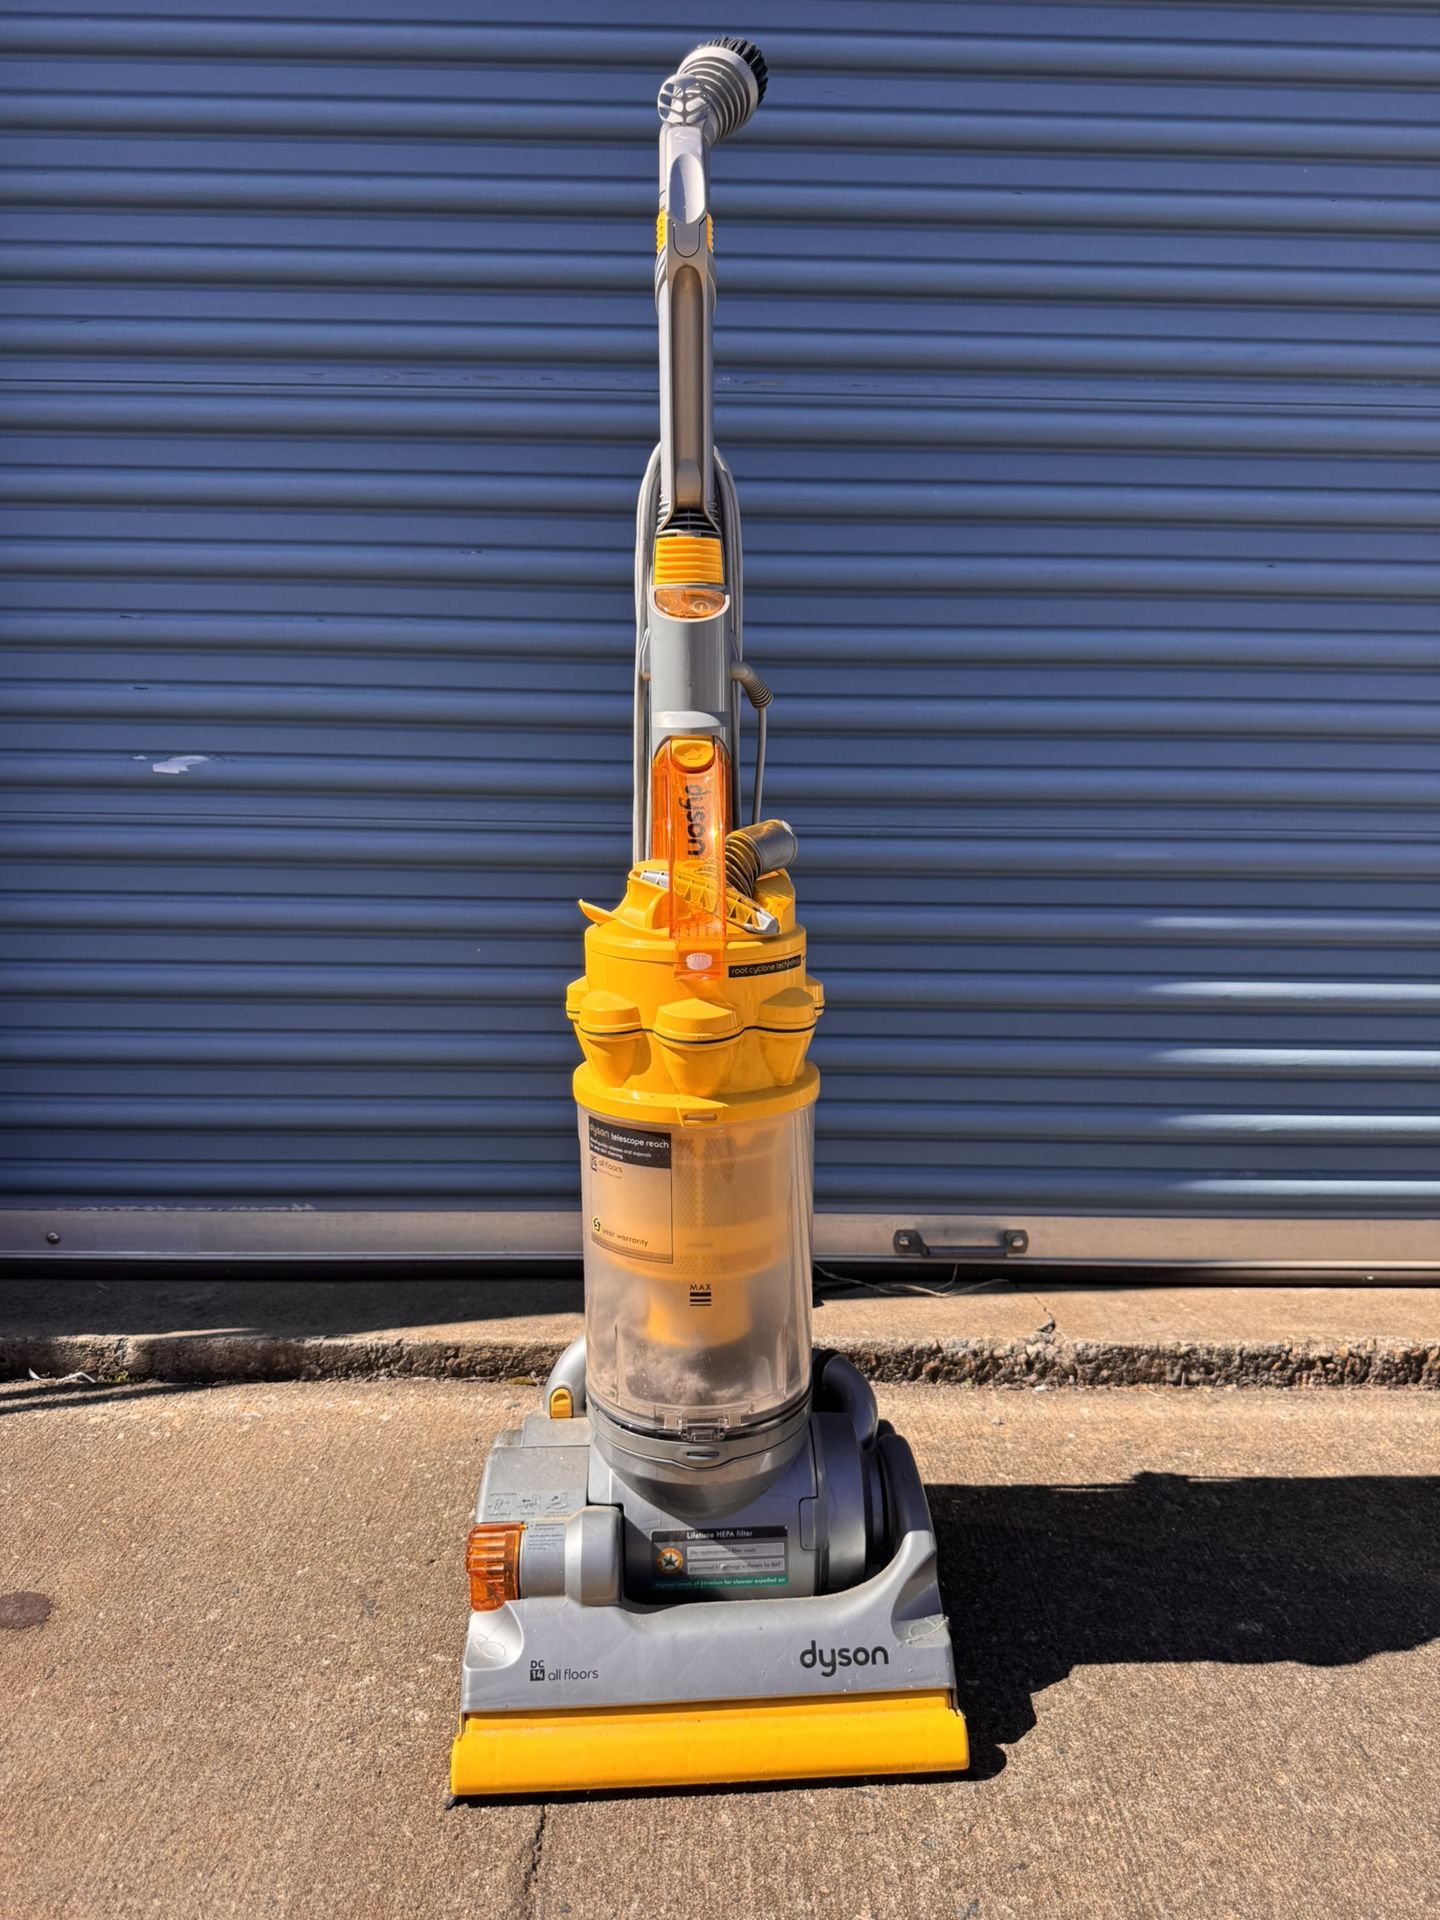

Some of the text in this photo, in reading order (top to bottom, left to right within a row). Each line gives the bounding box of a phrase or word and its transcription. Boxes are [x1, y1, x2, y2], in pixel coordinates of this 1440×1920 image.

[679, 784, 711, 855] dyson
[731, 967, 748, 975] root
[749, 964, 775, 974] cyclone
[611, 1132, 645, 1147] telescope
[645, 1140, 669, 1149] reach
[602, 1229, 649, 1247] year warranty
[687, 1529, 753, 1540] Lifetime HEPA filter
[530, 1660, 545, 1668] DC
[800, 1640, 889, 1677] dyson
[530, 1668, 599, 1681] 14 all floors
